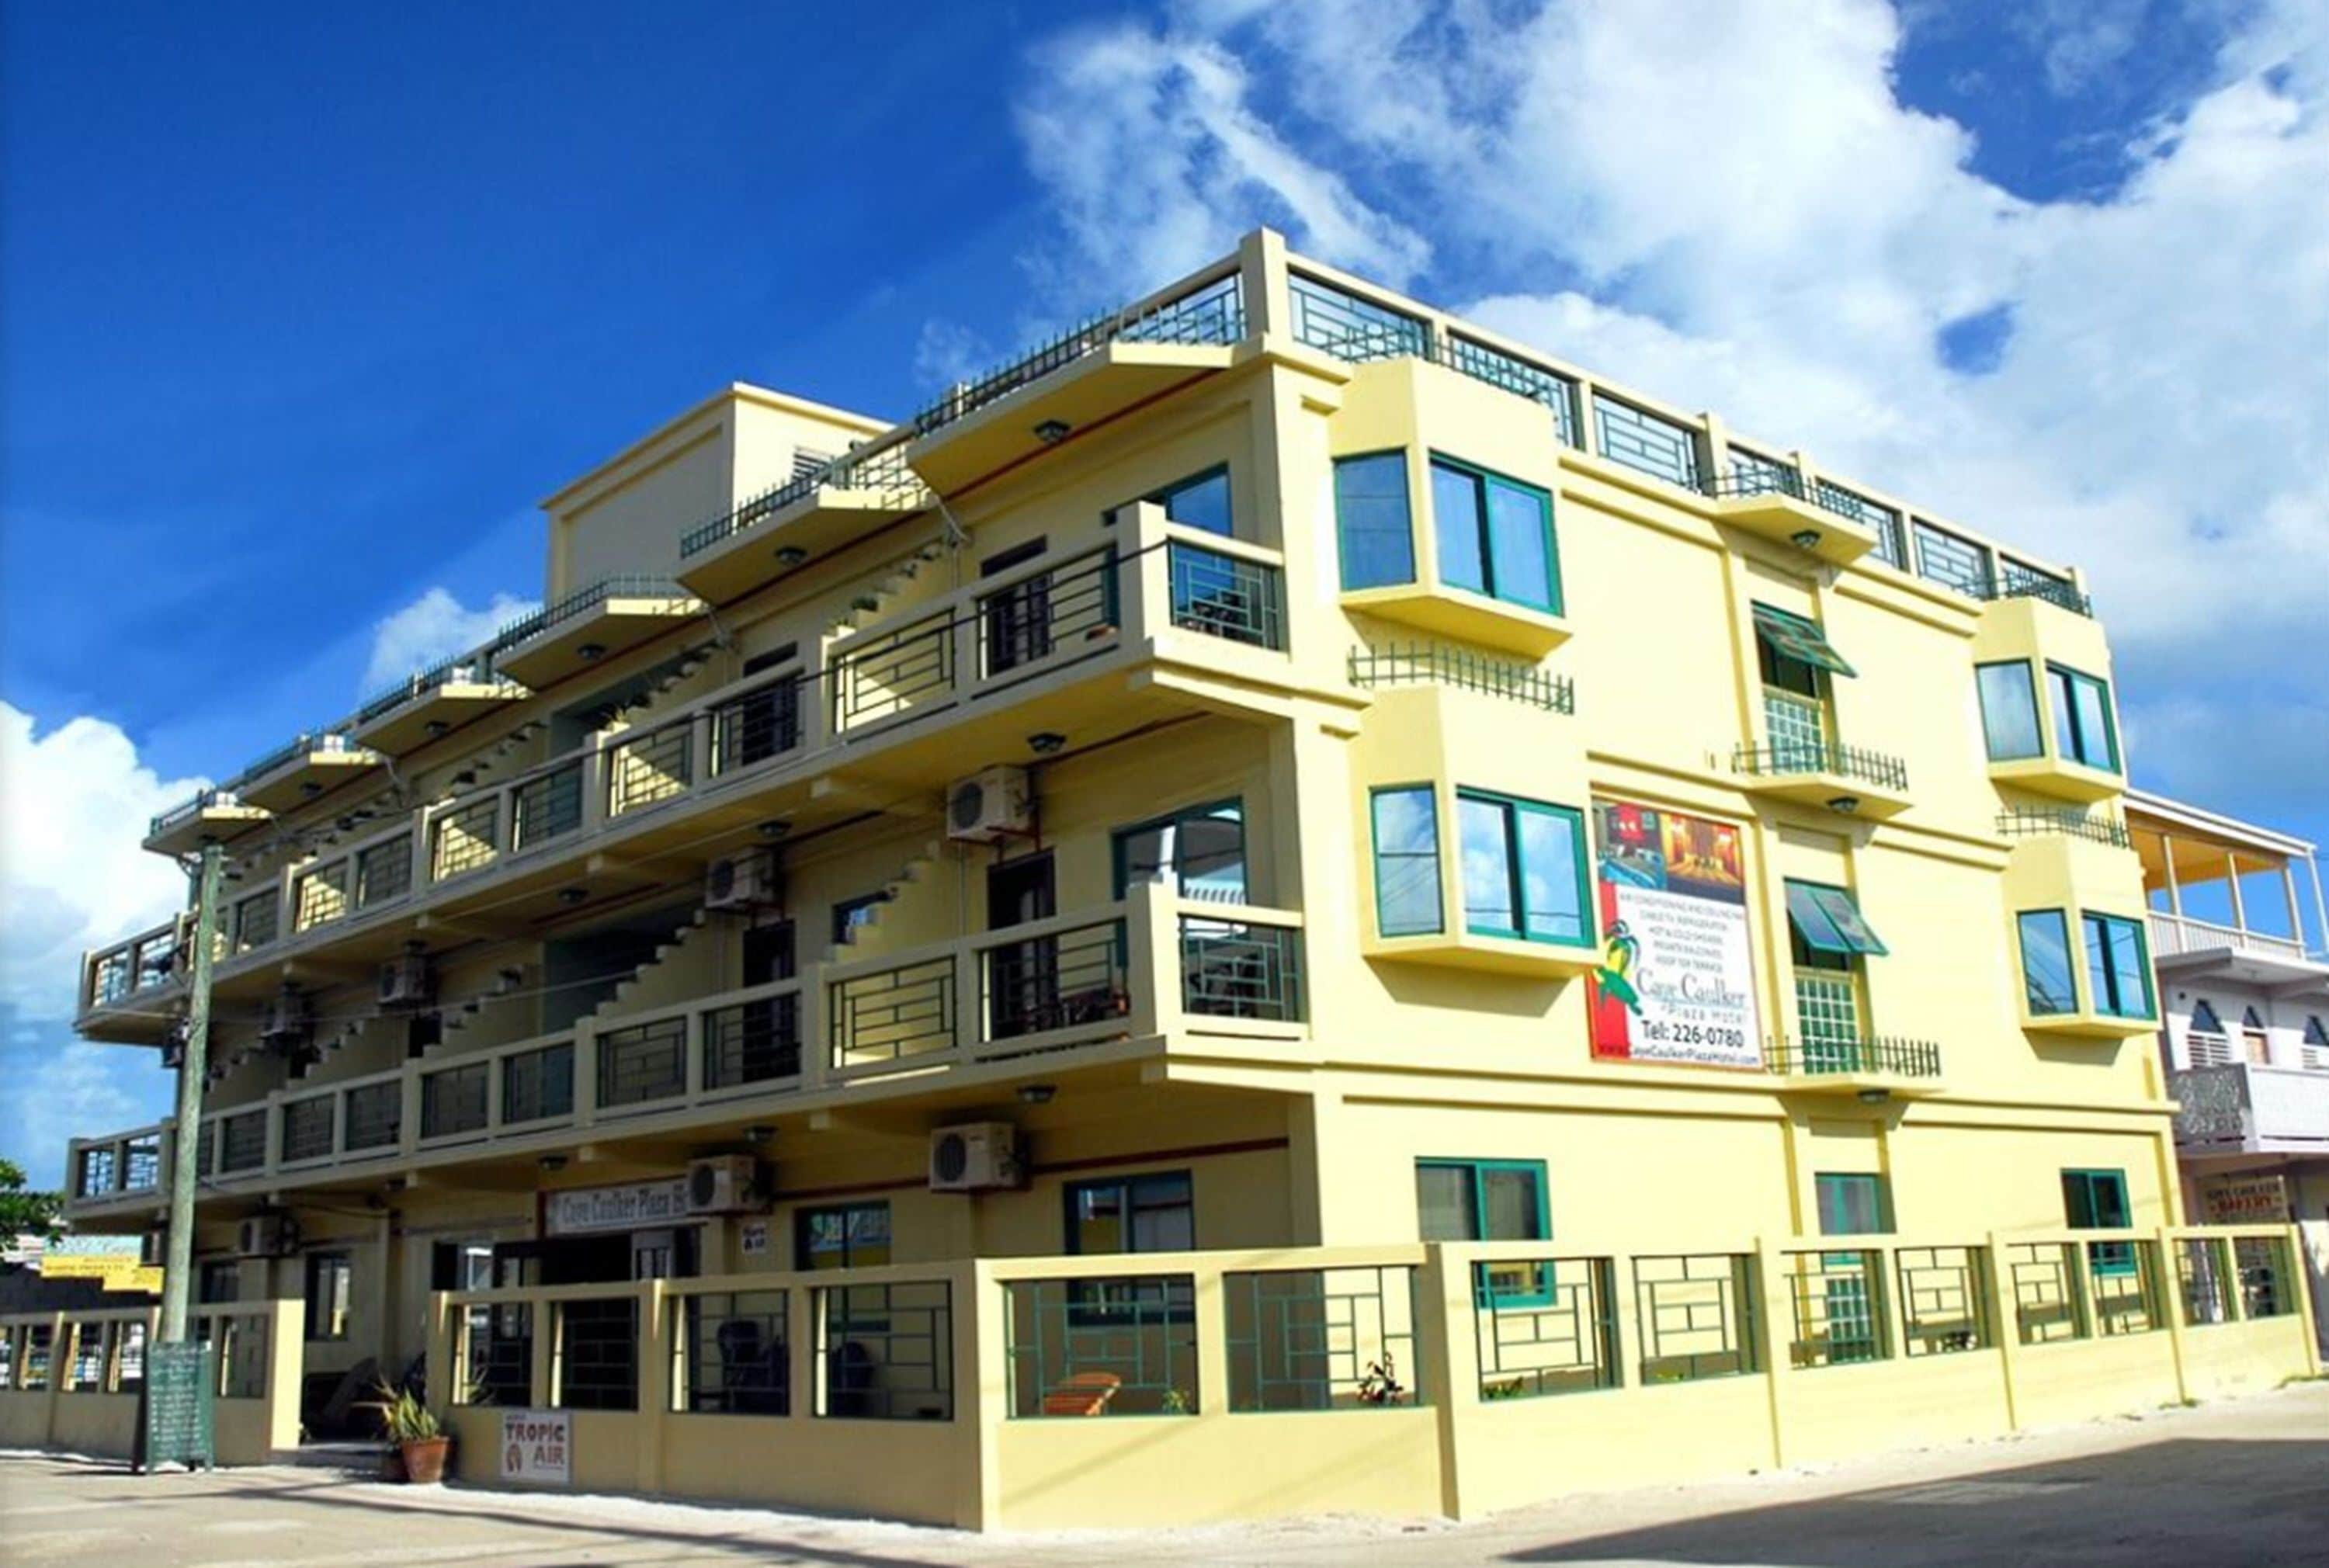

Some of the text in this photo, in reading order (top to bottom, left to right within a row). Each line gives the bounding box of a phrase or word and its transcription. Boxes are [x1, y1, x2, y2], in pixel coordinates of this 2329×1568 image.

[1637, 968, 1746, 1008] Caye Caulker
[1641, 1019, 1745, 1048] Tel: 226-0780
[592, 1192, 637, 1223] Caulker
[533, 1445, 565, 1466] AIR
